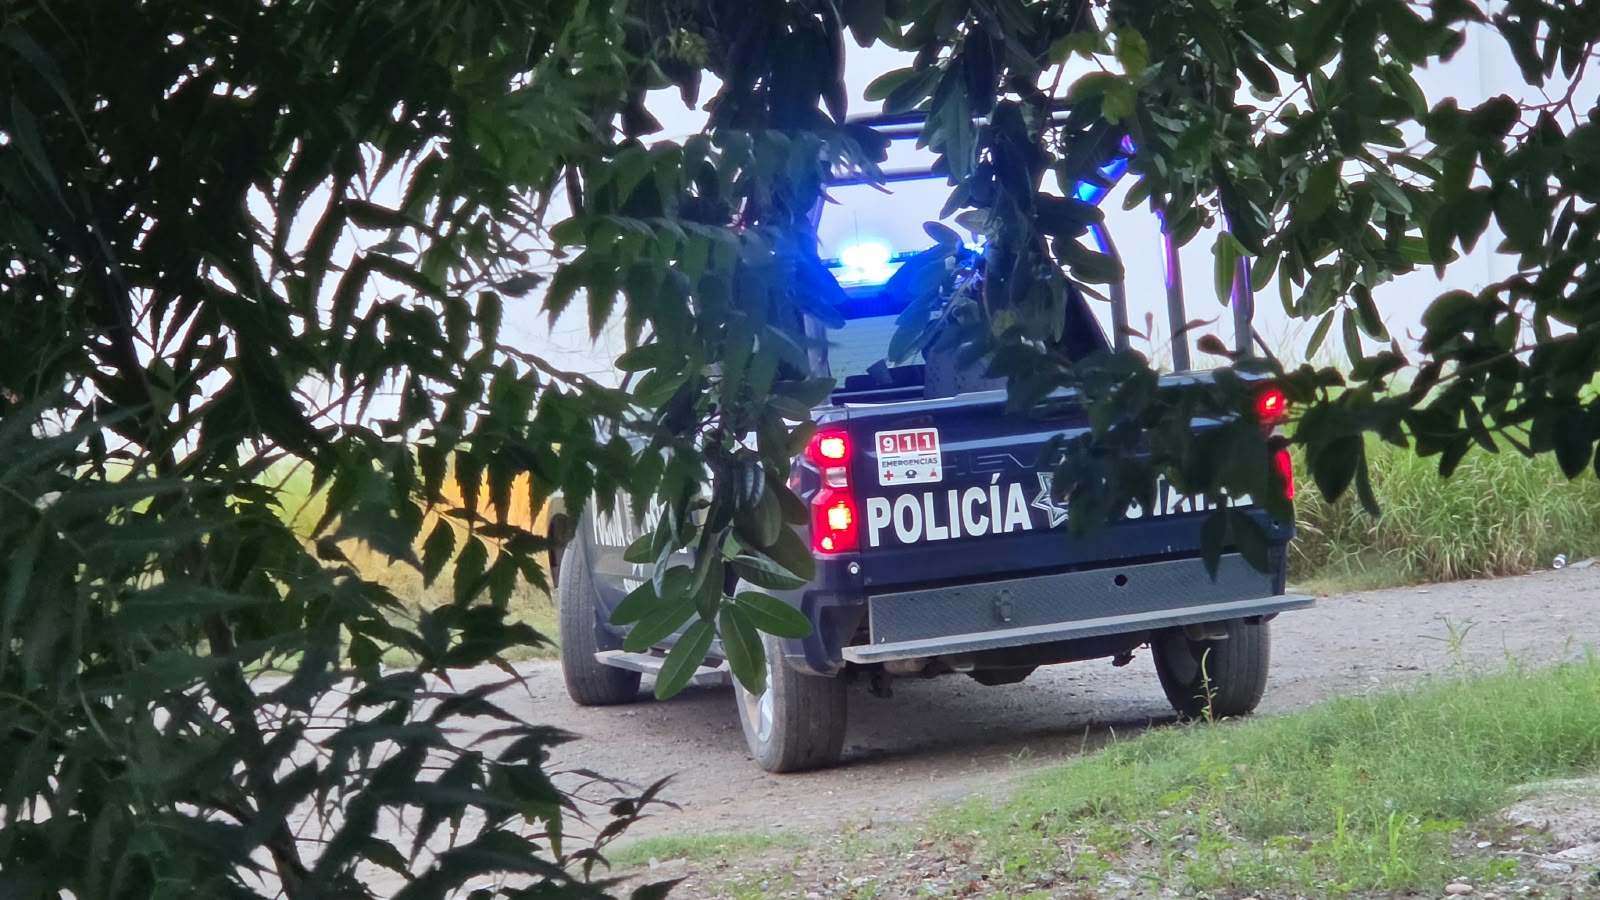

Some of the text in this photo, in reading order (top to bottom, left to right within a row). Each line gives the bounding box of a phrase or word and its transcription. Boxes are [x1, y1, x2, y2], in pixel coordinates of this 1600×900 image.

[882, 435, 931, 452] 911
[881, 457, 938, 468] EMERGENCIAS
[866, 473, 1033, 547] POLICÍA
